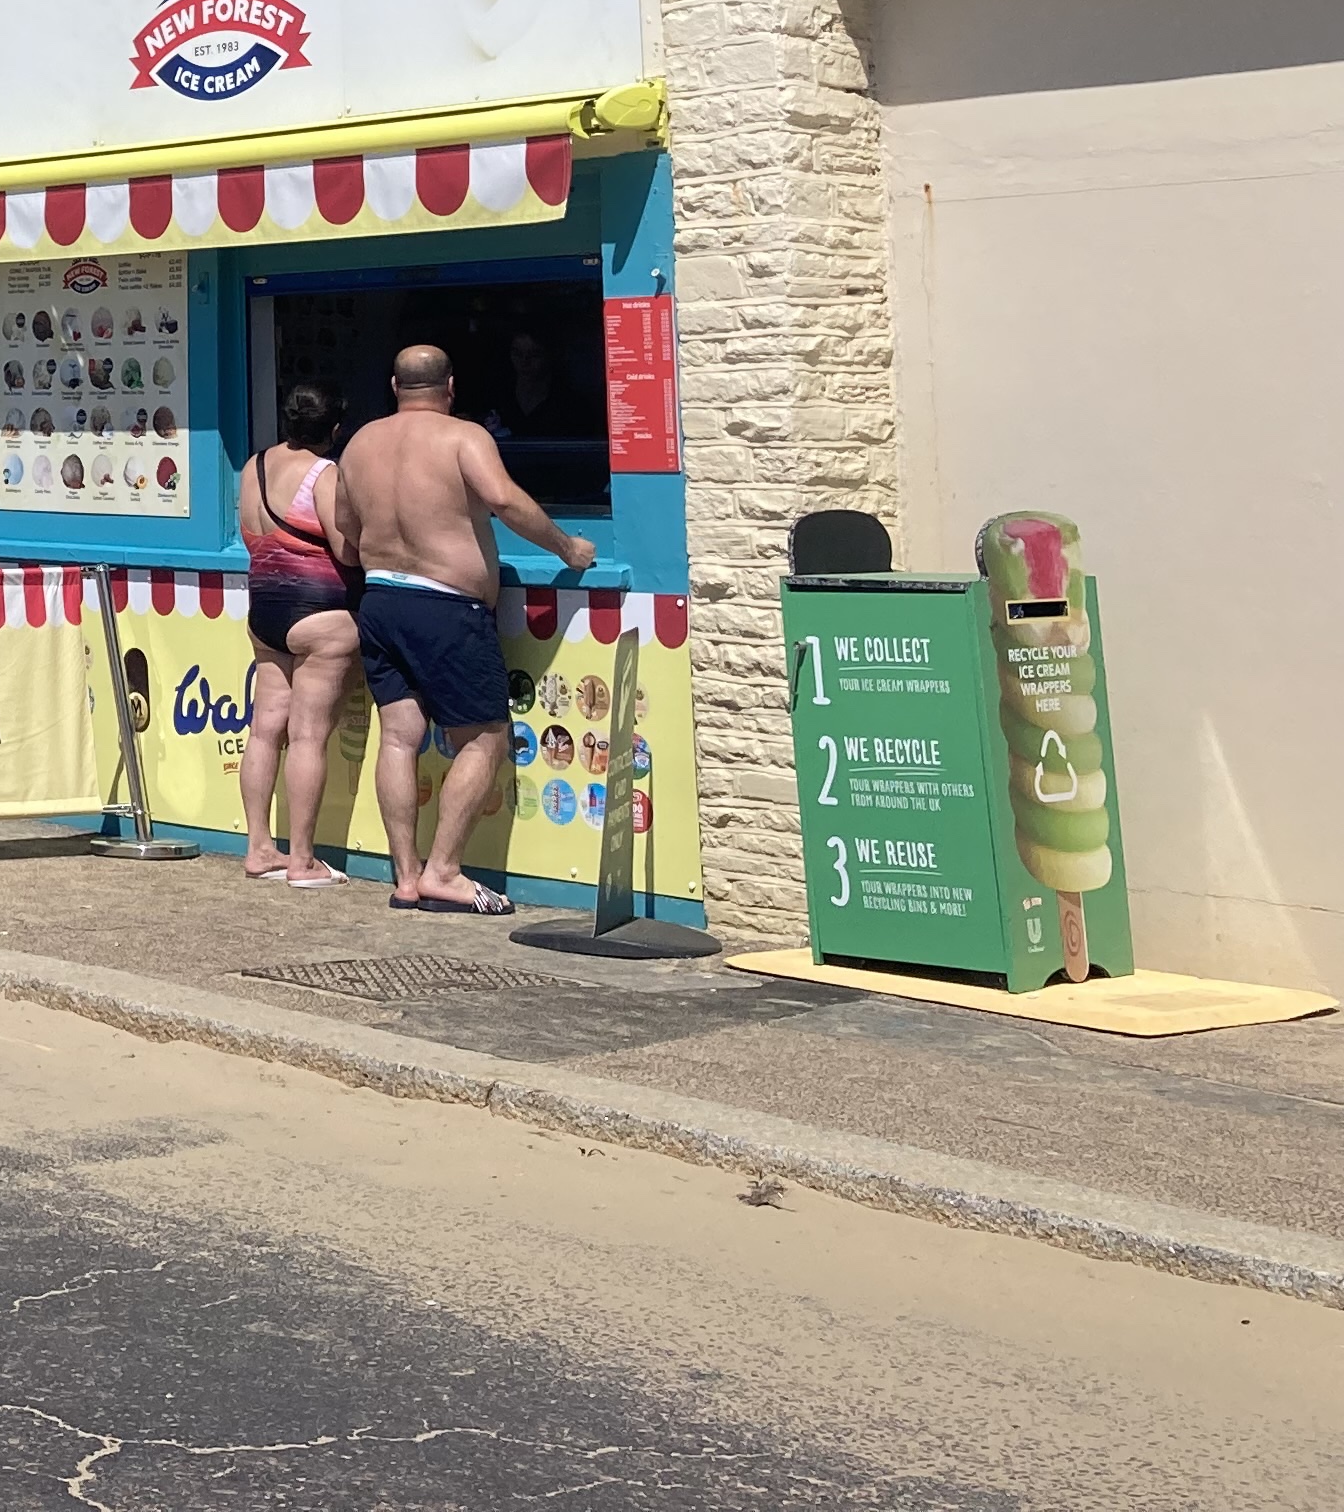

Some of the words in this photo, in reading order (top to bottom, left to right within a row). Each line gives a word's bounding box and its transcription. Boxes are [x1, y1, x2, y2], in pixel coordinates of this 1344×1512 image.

[144, 4, 196, 58] NEW
[194, 45, 213, 57] EST.
[216, 41, 239, 54] 1983
[174, 66, 200, 92] ICE
[203, 56, 261, 94] CREAM
[1008, 647, 1049, 662] RECYCLE
[1050, 645, 1077, 659] YOUR
[805, 636, 831, 706] 1
[834, 636, 860, 662] WE
[864, 637, 930, 663] COLLECT
[1019, 665, 1035, 679] ICE
[1036, 663, 1070, 678] CREAM
[839, 678, 860, 691] YOUR
[861, 678, 874, 692] ICE
[876, 679, 904, 693] CREAM
[905, 679, 950, 694] WRAPPERS
[1020, 680, 1071, 696] WRAPPERS
[1036, 698, 1061, 712] HERE
[217, 739, 244, 756] ICE
[818, 735, 838, 806] 2
[844, 736, 869, 762] WE
[874, 737, 941, 765] RECYCLE
[849, 778, 871, 792] YOUR
[872, 779, 914, 795] WRAPPERS
[916, 781, 939, 796] WITH
[942, 783, 974, 798] OTHERS
[851, 794, 873, 807] FROM
[876, 796, 909, 810] AROUND
[910, 797, 927, 811] THE
[929, 798, 942, 812] UK
[827, 836, 850, 907] 3
[854, 837, 881, 864] WE
[885, 840, 938, 869] REUSE
[861, 880, 883, 894] YOUR
[883, 881, 928, 898] WRAPPERS
[929, 886, 950, 900] INTO
[952, 887, 973, 901] NEW
[863, 896, 906, 912] RECYCLING
[908, 899, 928, 914] BINS
[930, 901, 937, 914] &
[939, 902, 967, 917] MORE!
